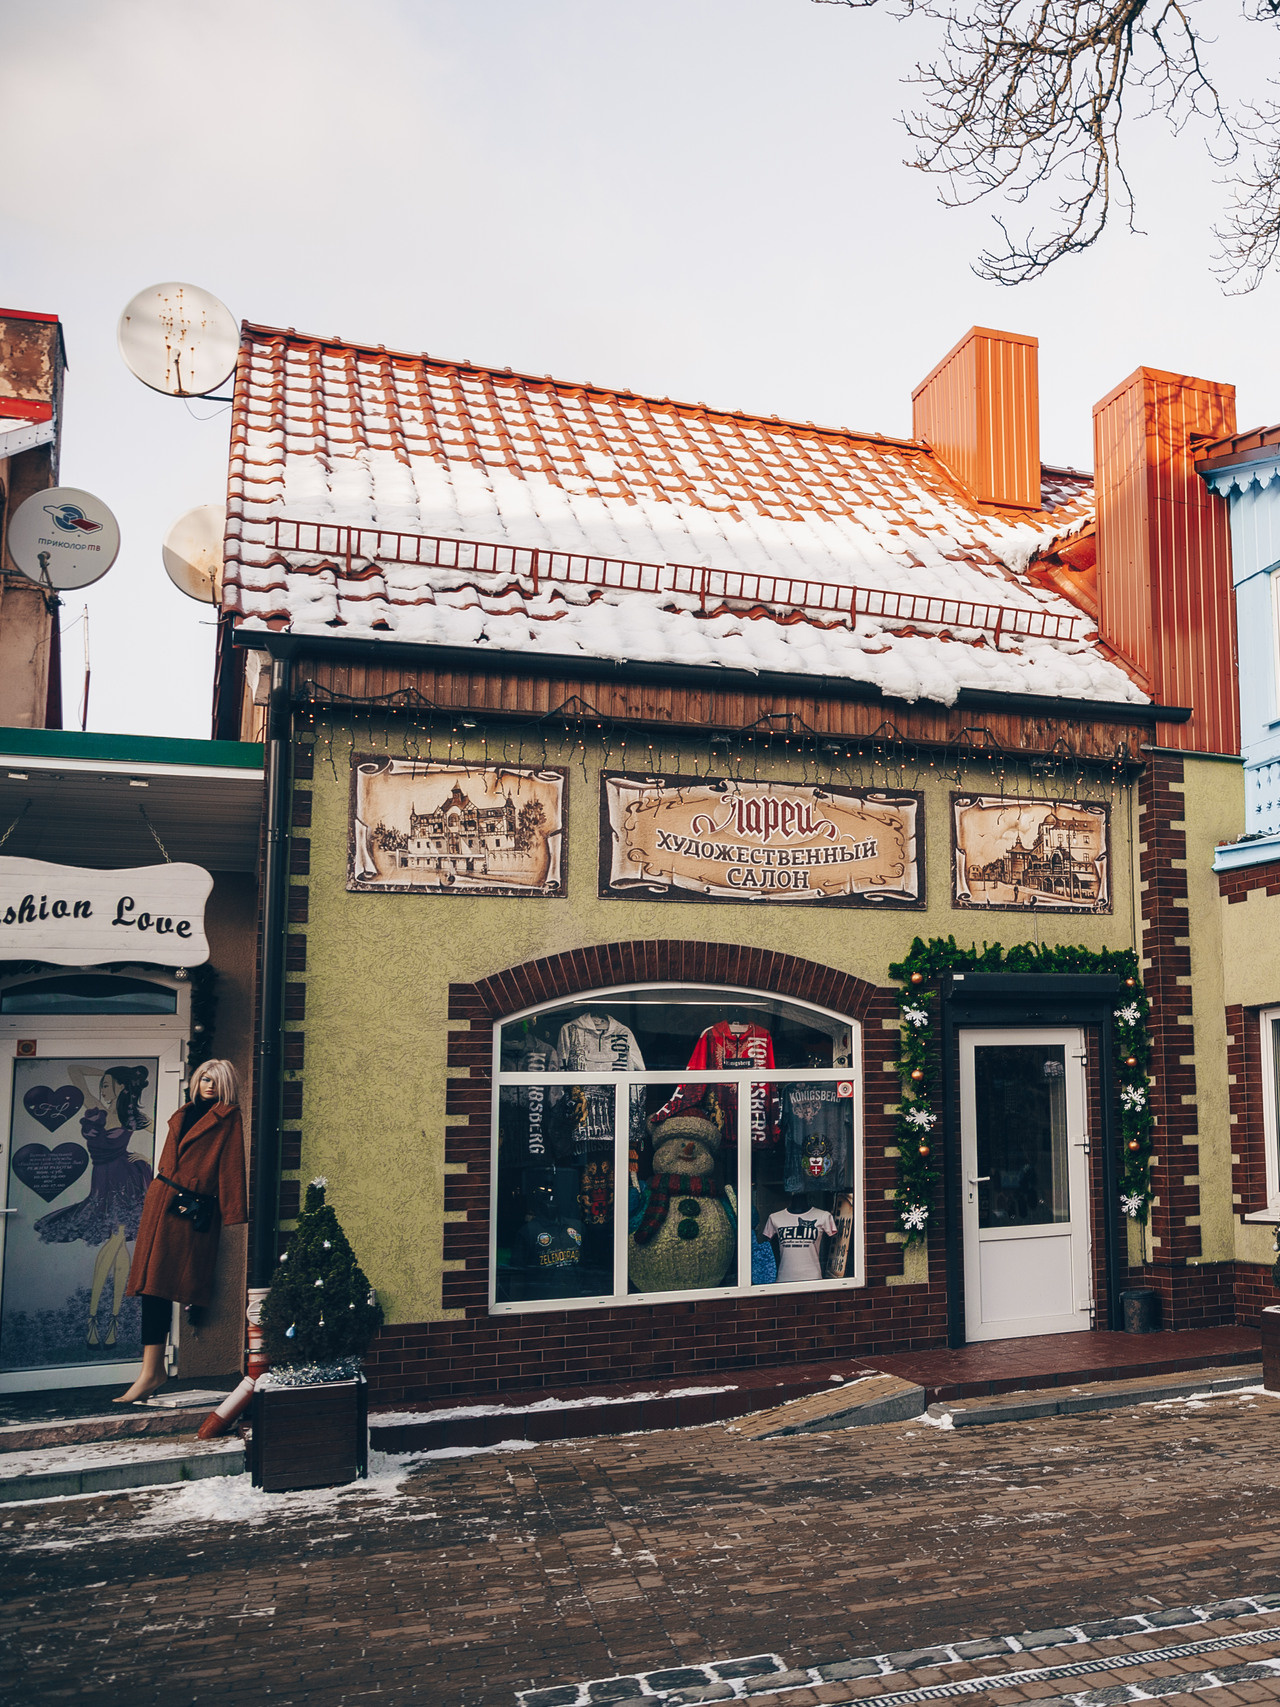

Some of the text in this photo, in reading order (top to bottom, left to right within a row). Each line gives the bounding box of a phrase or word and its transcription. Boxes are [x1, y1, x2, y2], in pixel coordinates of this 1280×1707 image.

[690, 794, 837, 843] Ларец
[656, 830, 878, 867] ХУДОЖЕСТВЕННЫЙ
[726, 867, 809, 889] САЛОН
[0, 895, 193, 938] shion Love
